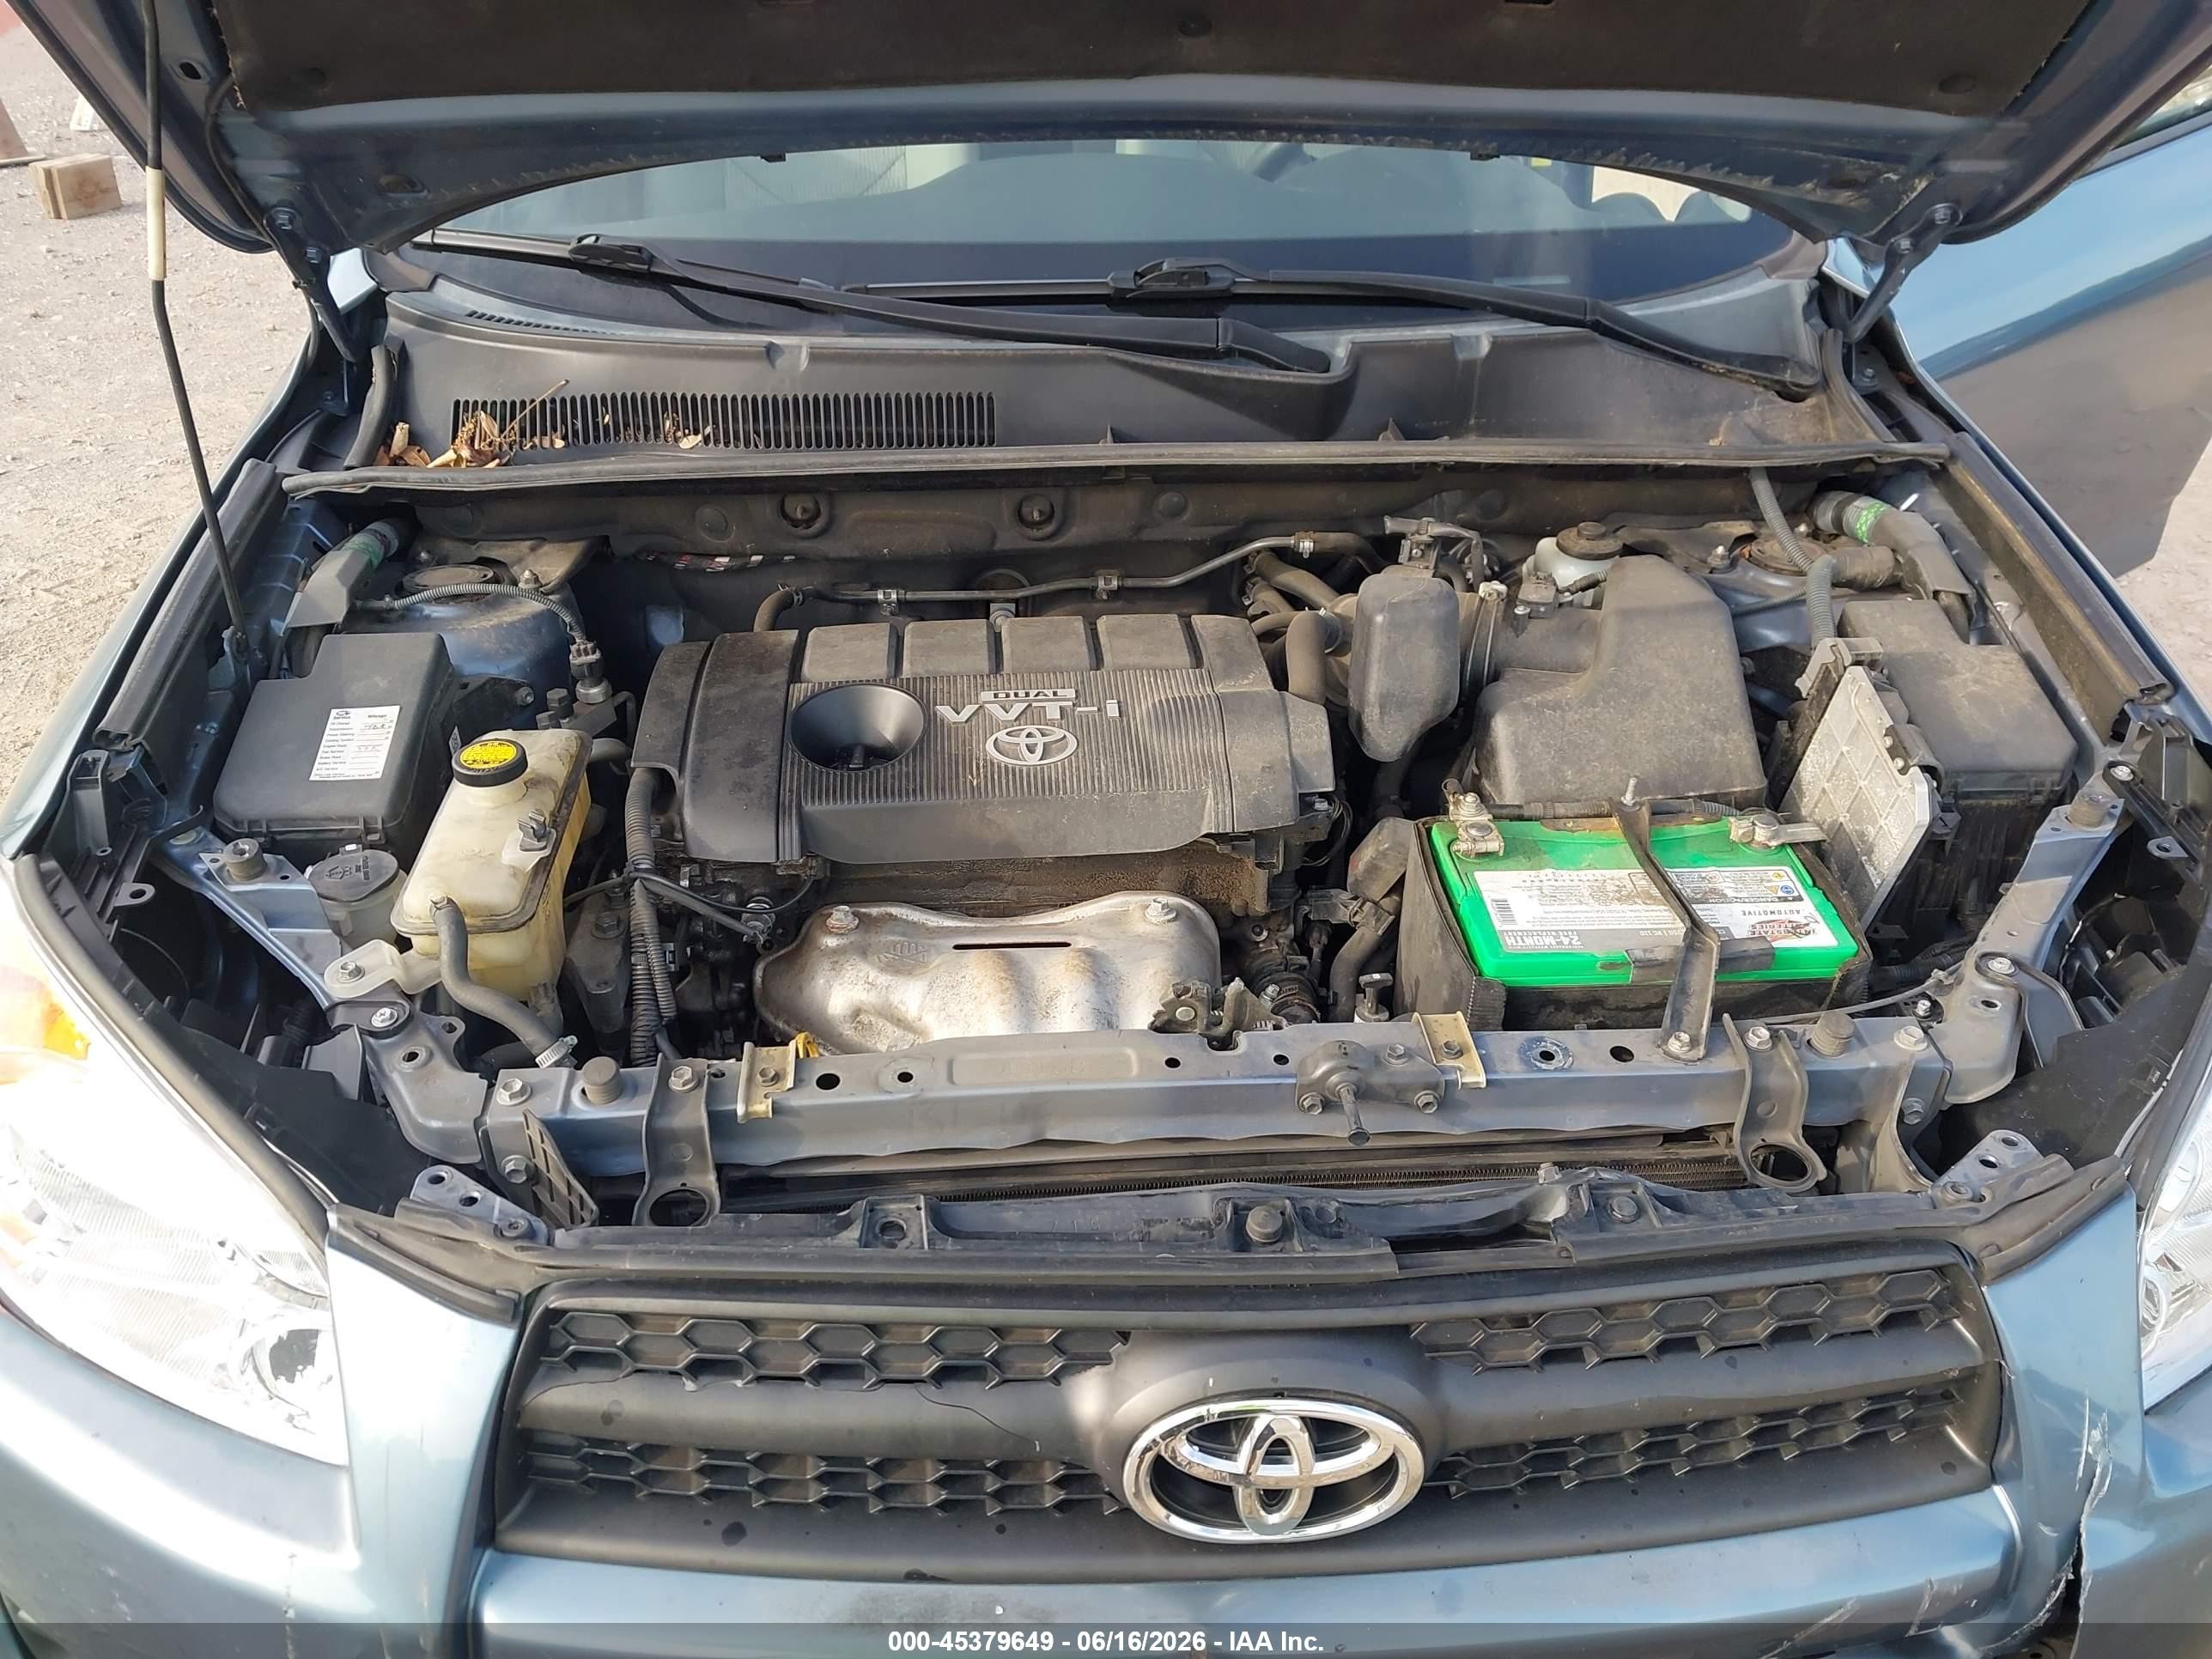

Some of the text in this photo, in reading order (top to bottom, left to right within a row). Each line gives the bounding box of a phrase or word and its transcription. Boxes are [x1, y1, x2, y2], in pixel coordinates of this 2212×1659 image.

[993, 690, 1067, 699] DUAL
[935, 700, 1120, 725] VVT-i
[1504, 935, 1582, 945] 24-MONTH
